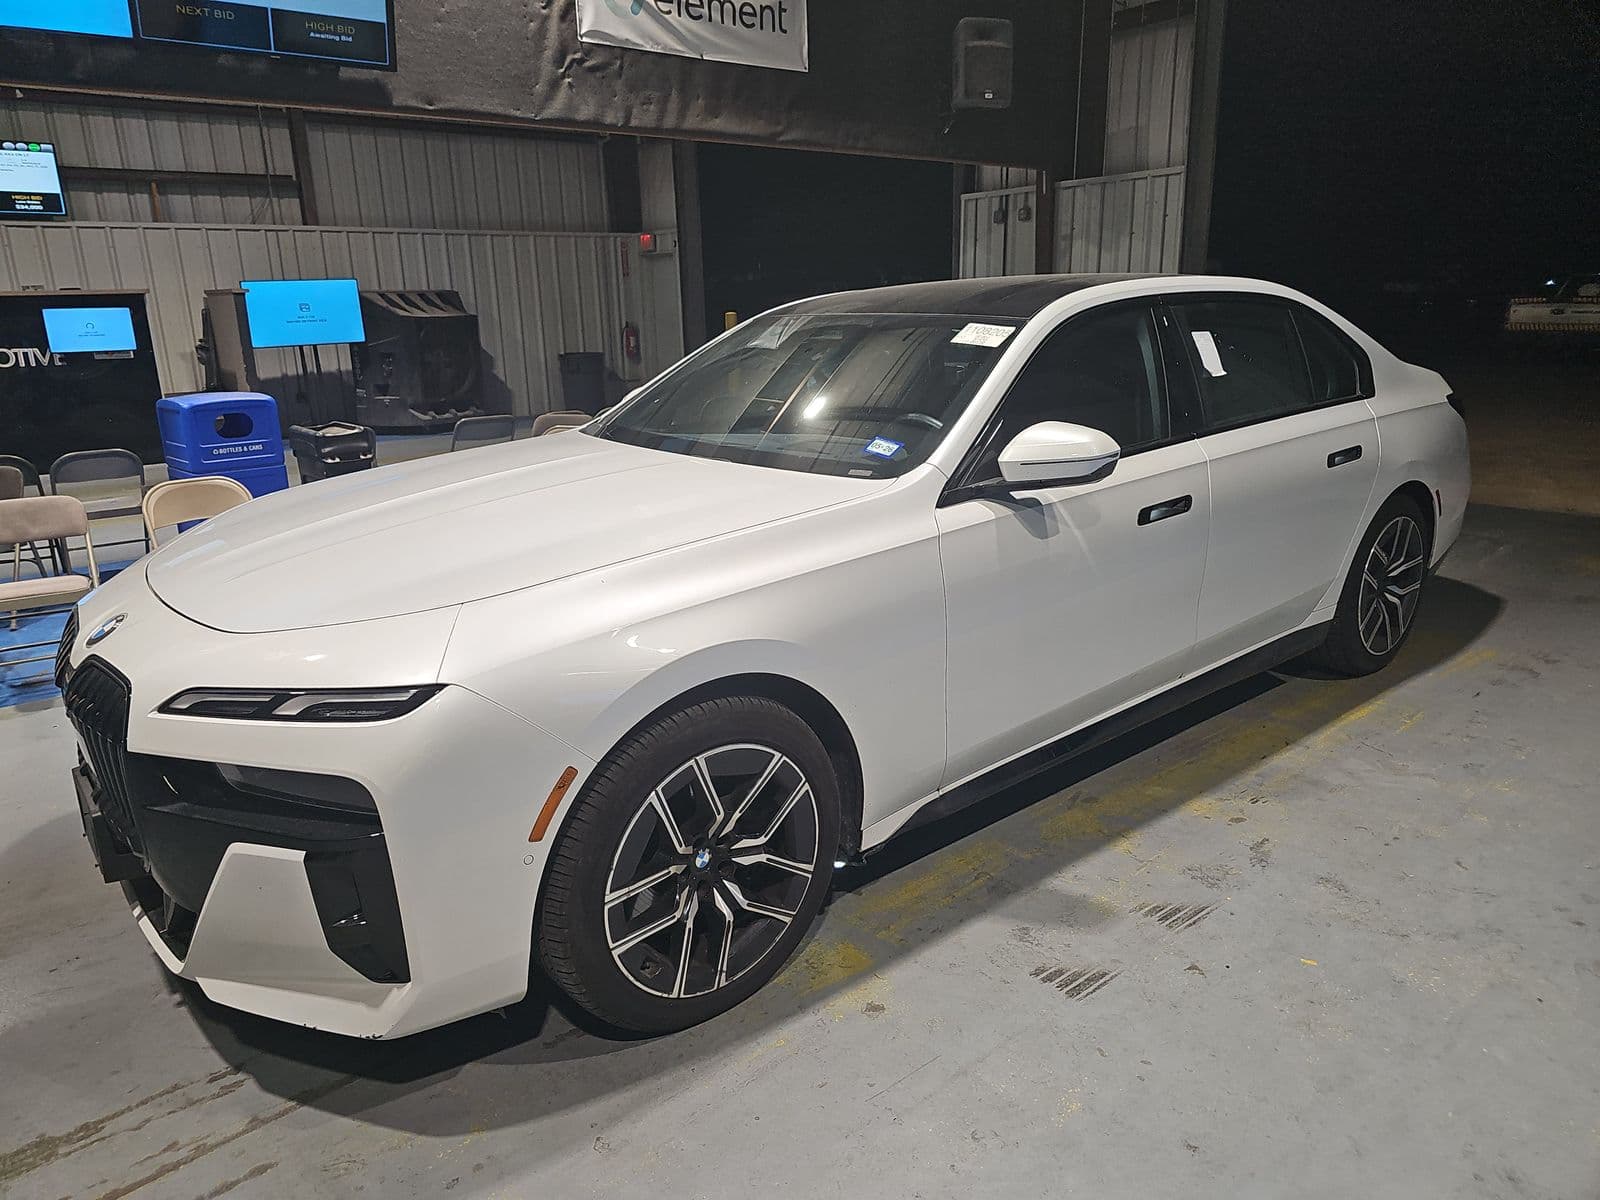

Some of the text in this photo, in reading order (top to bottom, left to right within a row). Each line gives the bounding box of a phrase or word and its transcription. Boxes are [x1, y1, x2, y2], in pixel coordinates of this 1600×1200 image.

[176, 4, 235, 20] NEXT BID
[305, 20, 356, 35] HIGH BID
[310, 31, 340, 41] Awaiting
[219, 446, 243, 454] BOTTLES
